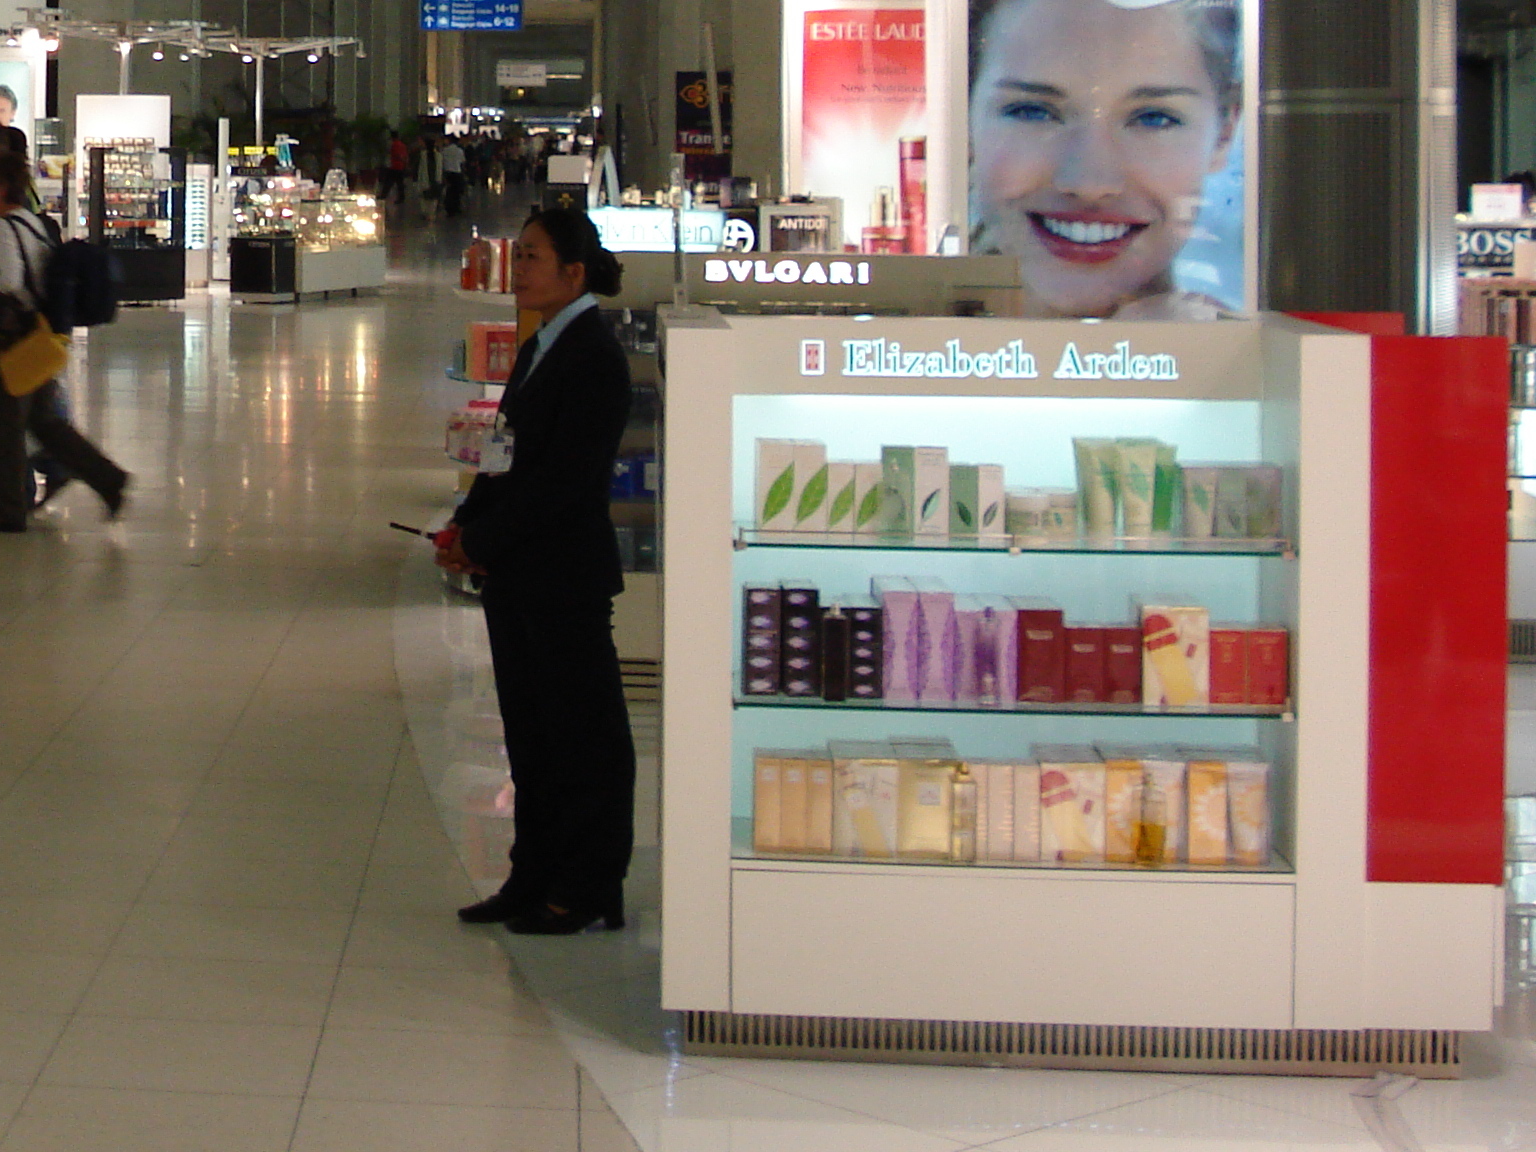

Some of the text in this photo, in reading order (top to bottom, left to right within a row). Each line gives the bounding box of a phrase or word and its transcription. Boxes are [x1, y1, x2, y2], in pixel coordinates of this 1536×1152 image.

[703, 259, 871, 285] BVLGARI
[841, 337, 1180, 380] Elizabeth Arden
